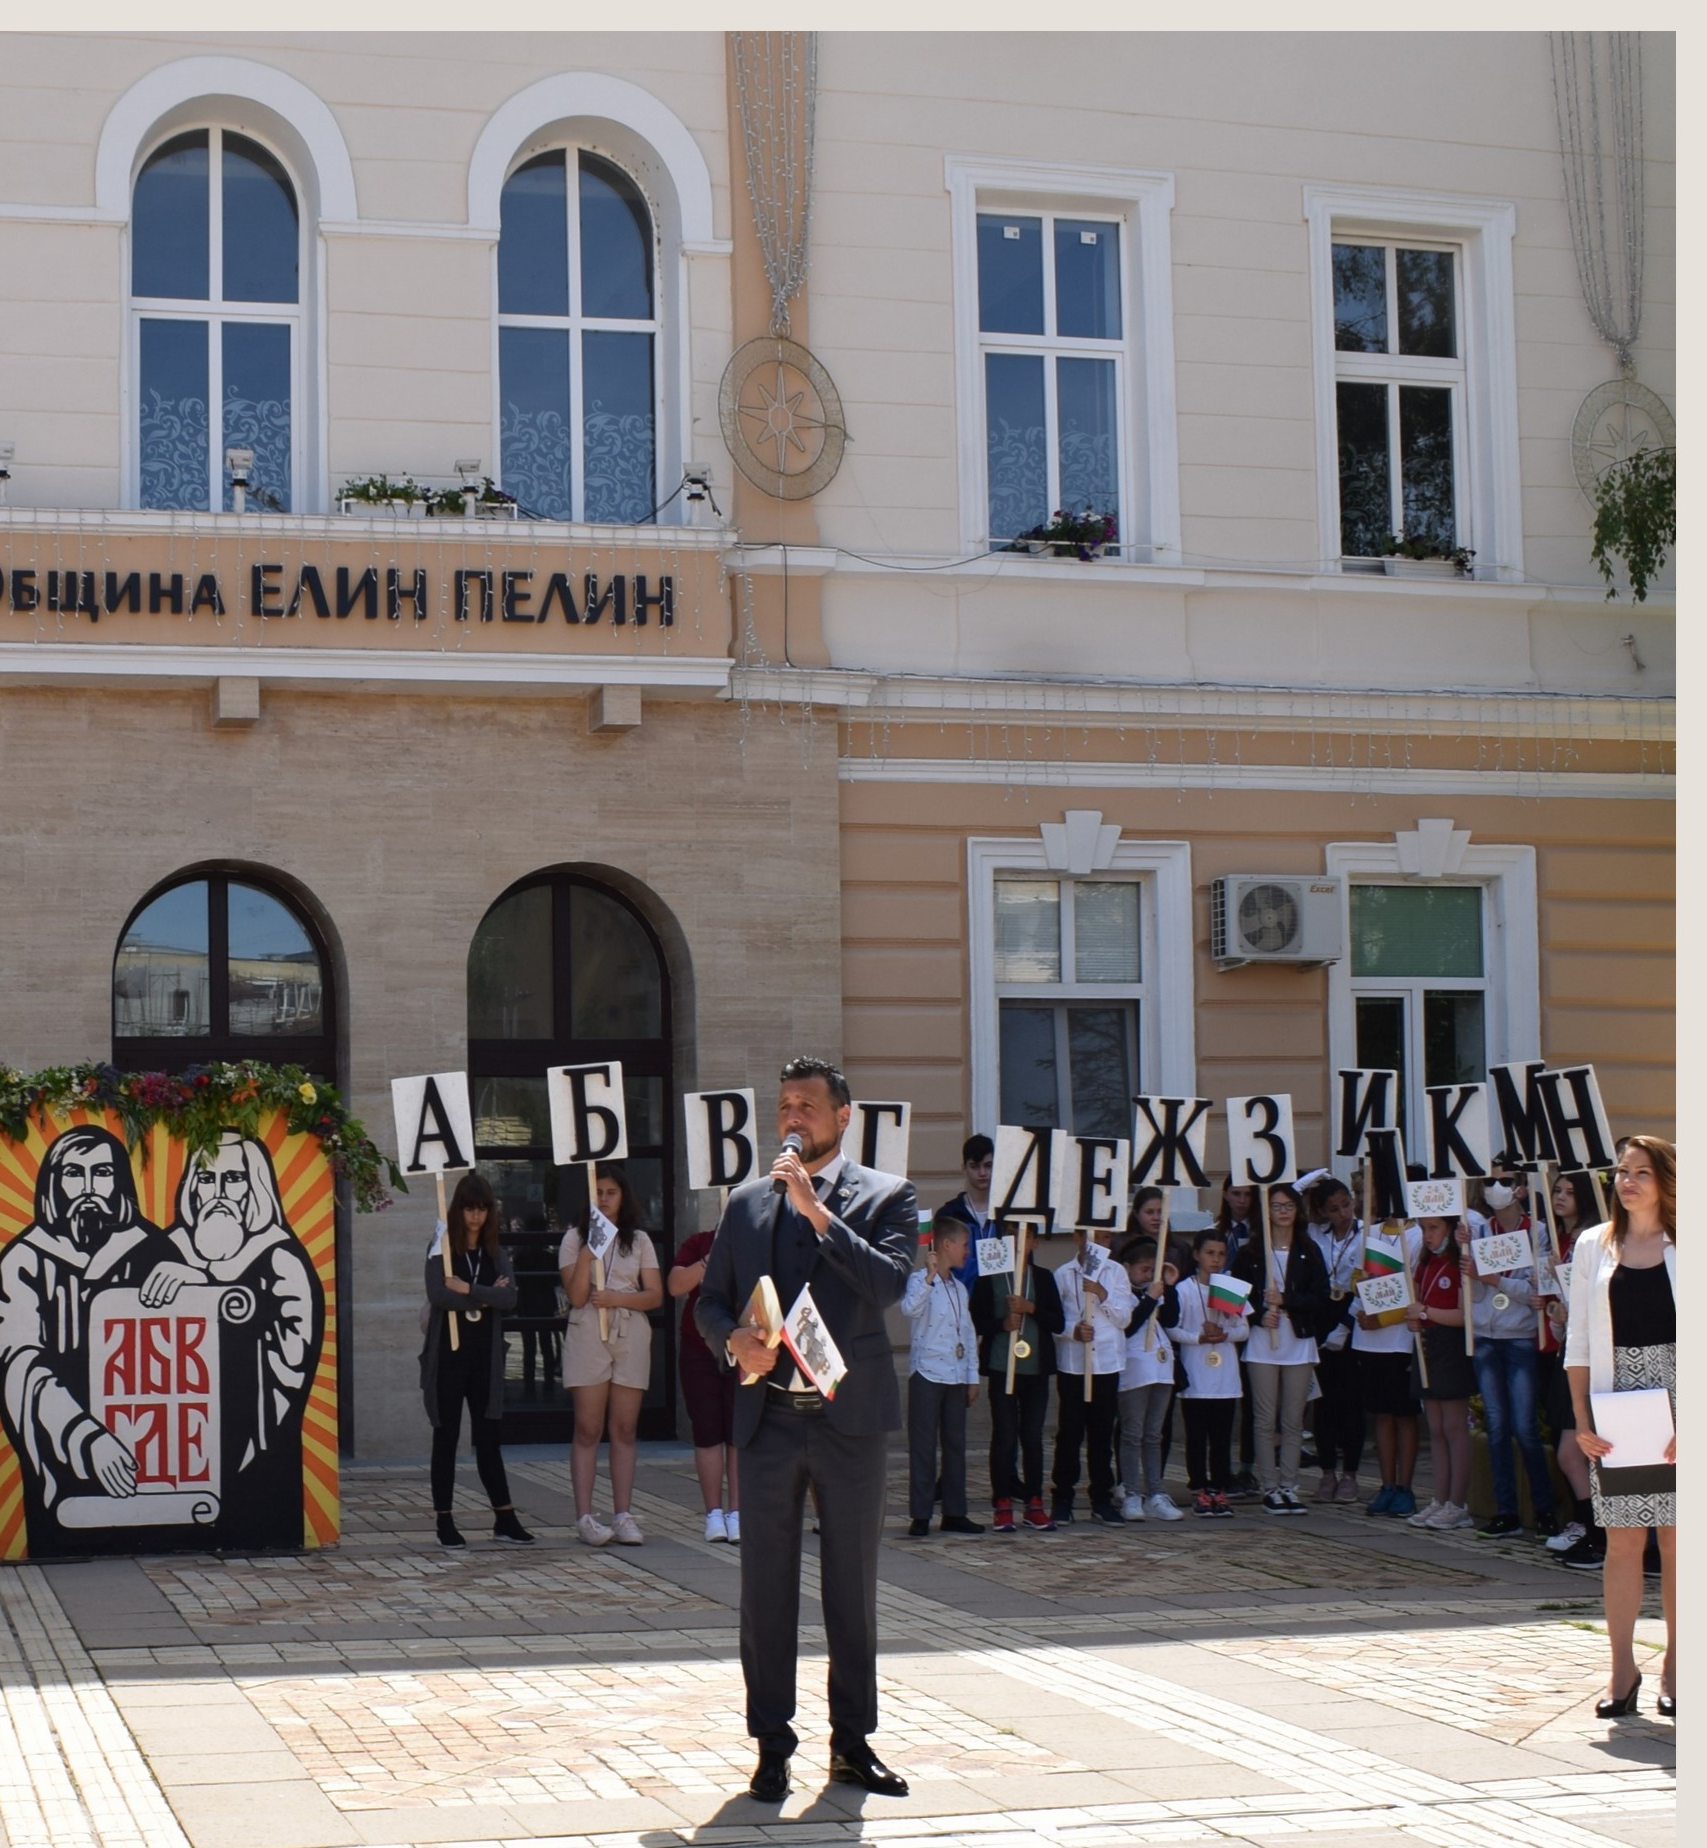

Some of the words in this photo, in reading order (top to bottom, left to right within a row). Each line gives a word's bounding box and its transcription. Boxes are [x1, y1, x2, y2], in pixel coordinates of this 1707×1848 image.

[251, 564, 429, 622] ЕЛИН
[452, 568, 677, 628] ПЕЛИН
[411, 1074, 470, 1171] А
[563, 1067, 620, 1163] Б
[706, 1092, 752, 1188] В
[1131, 1096, 1214, 1188] Ж
[1244, 1095, 1287, 1186] З
[1337, 1070, 1393, 1158] И
[1425, 1085, 1486, 1180] К
[1535, 1068, 1613, 1172] Н
[994, 1126, 1067, 1240] Д
[1074, 1137, 1118, 1232] Е
[103, 1316, 211, 1398] АБВ
